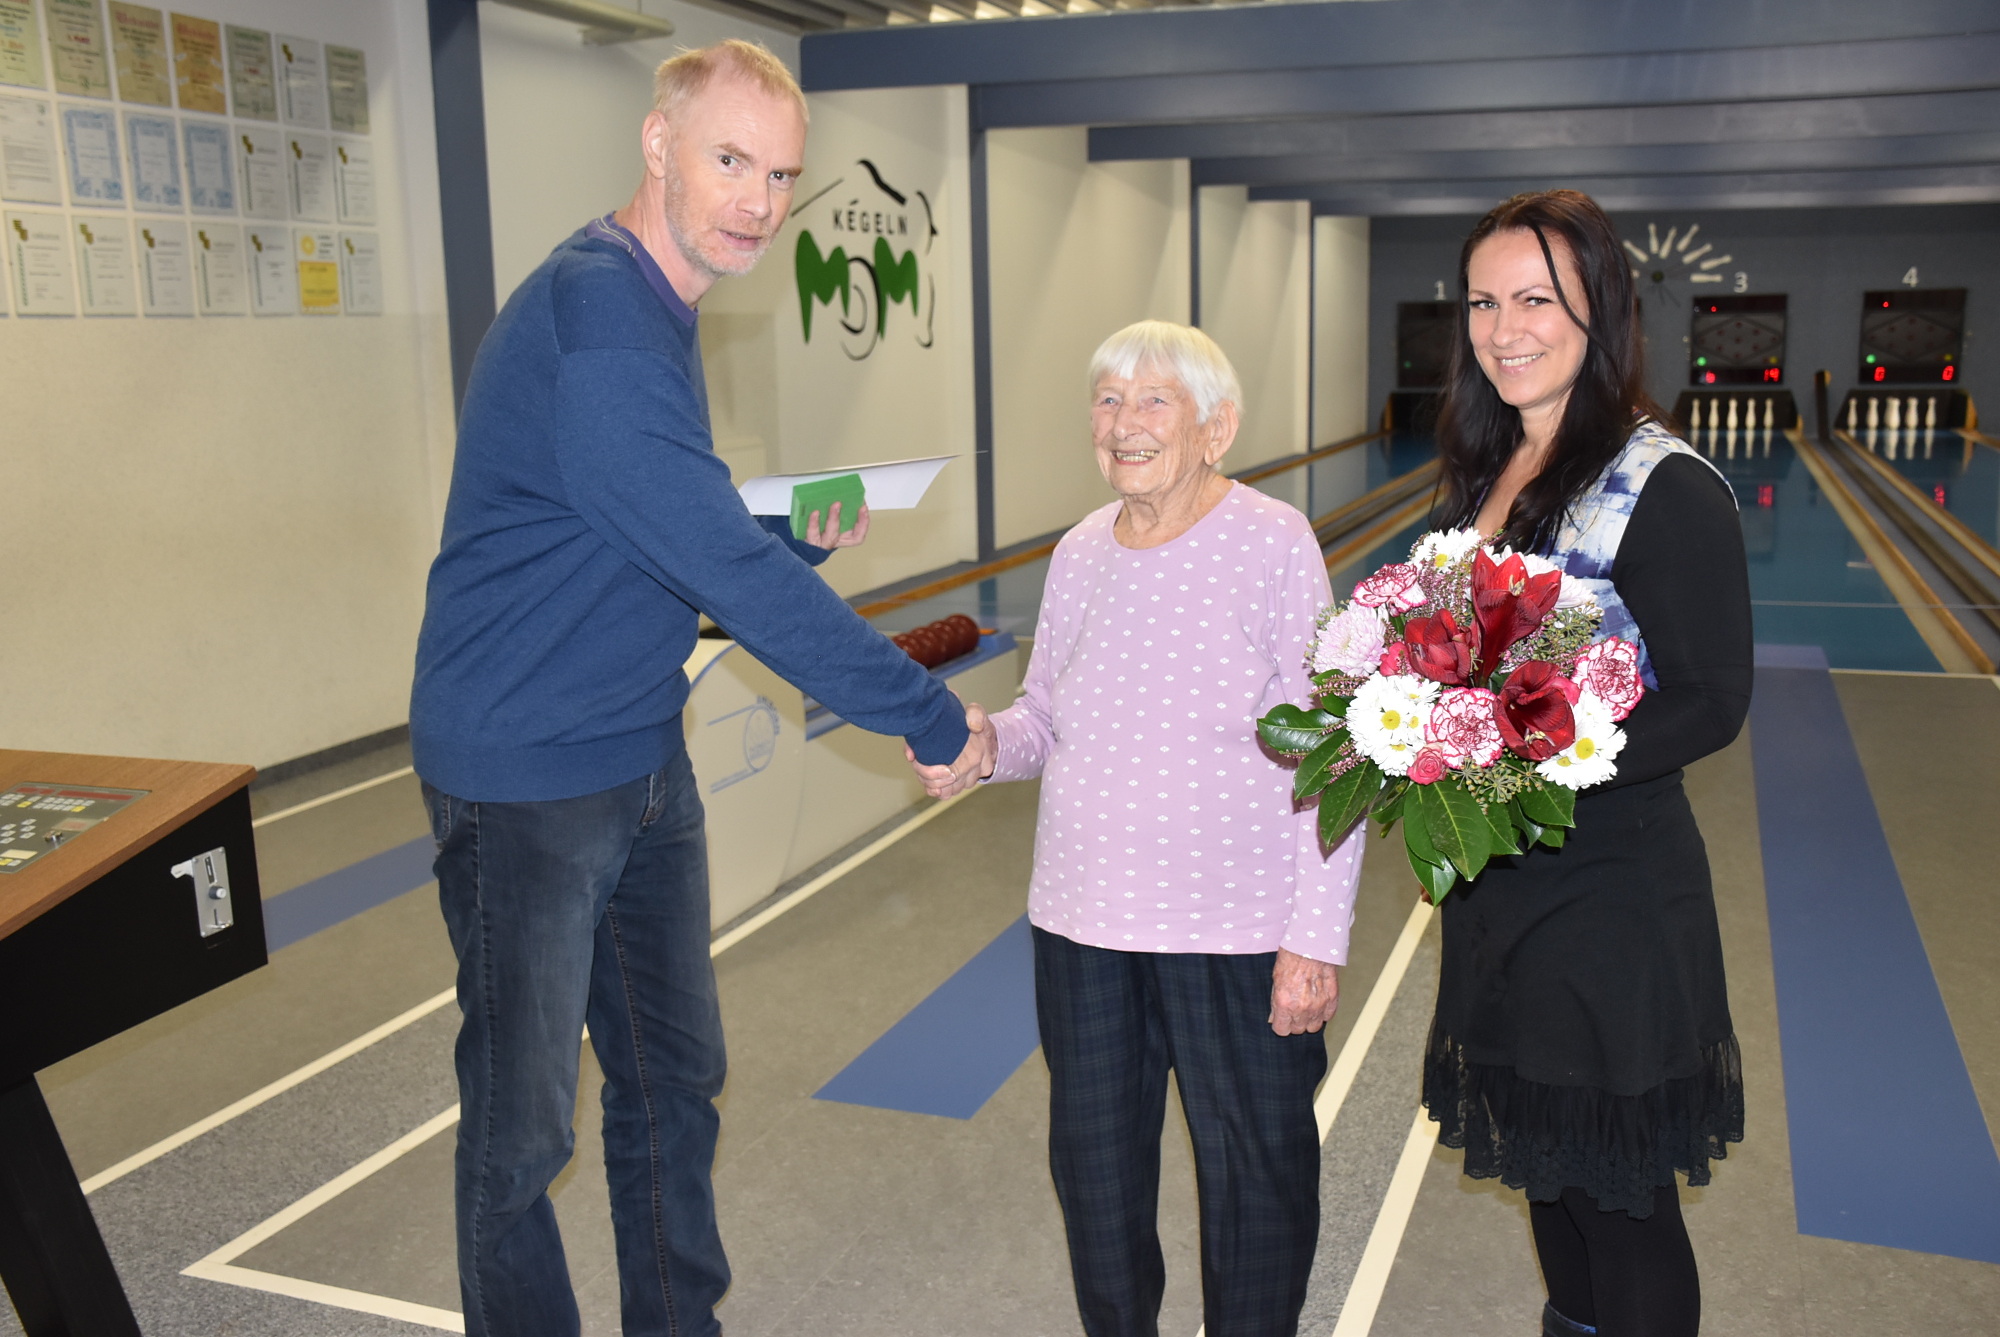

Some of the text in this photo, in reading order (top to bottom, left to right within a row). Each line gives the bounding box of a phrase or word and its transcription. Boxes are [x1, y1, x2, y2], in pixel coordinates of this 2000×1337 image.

[1733, 271, 1749, 293] 3
[1902, 266, 1919, 288] 4
[1434, 280, 1446, 301] 1
